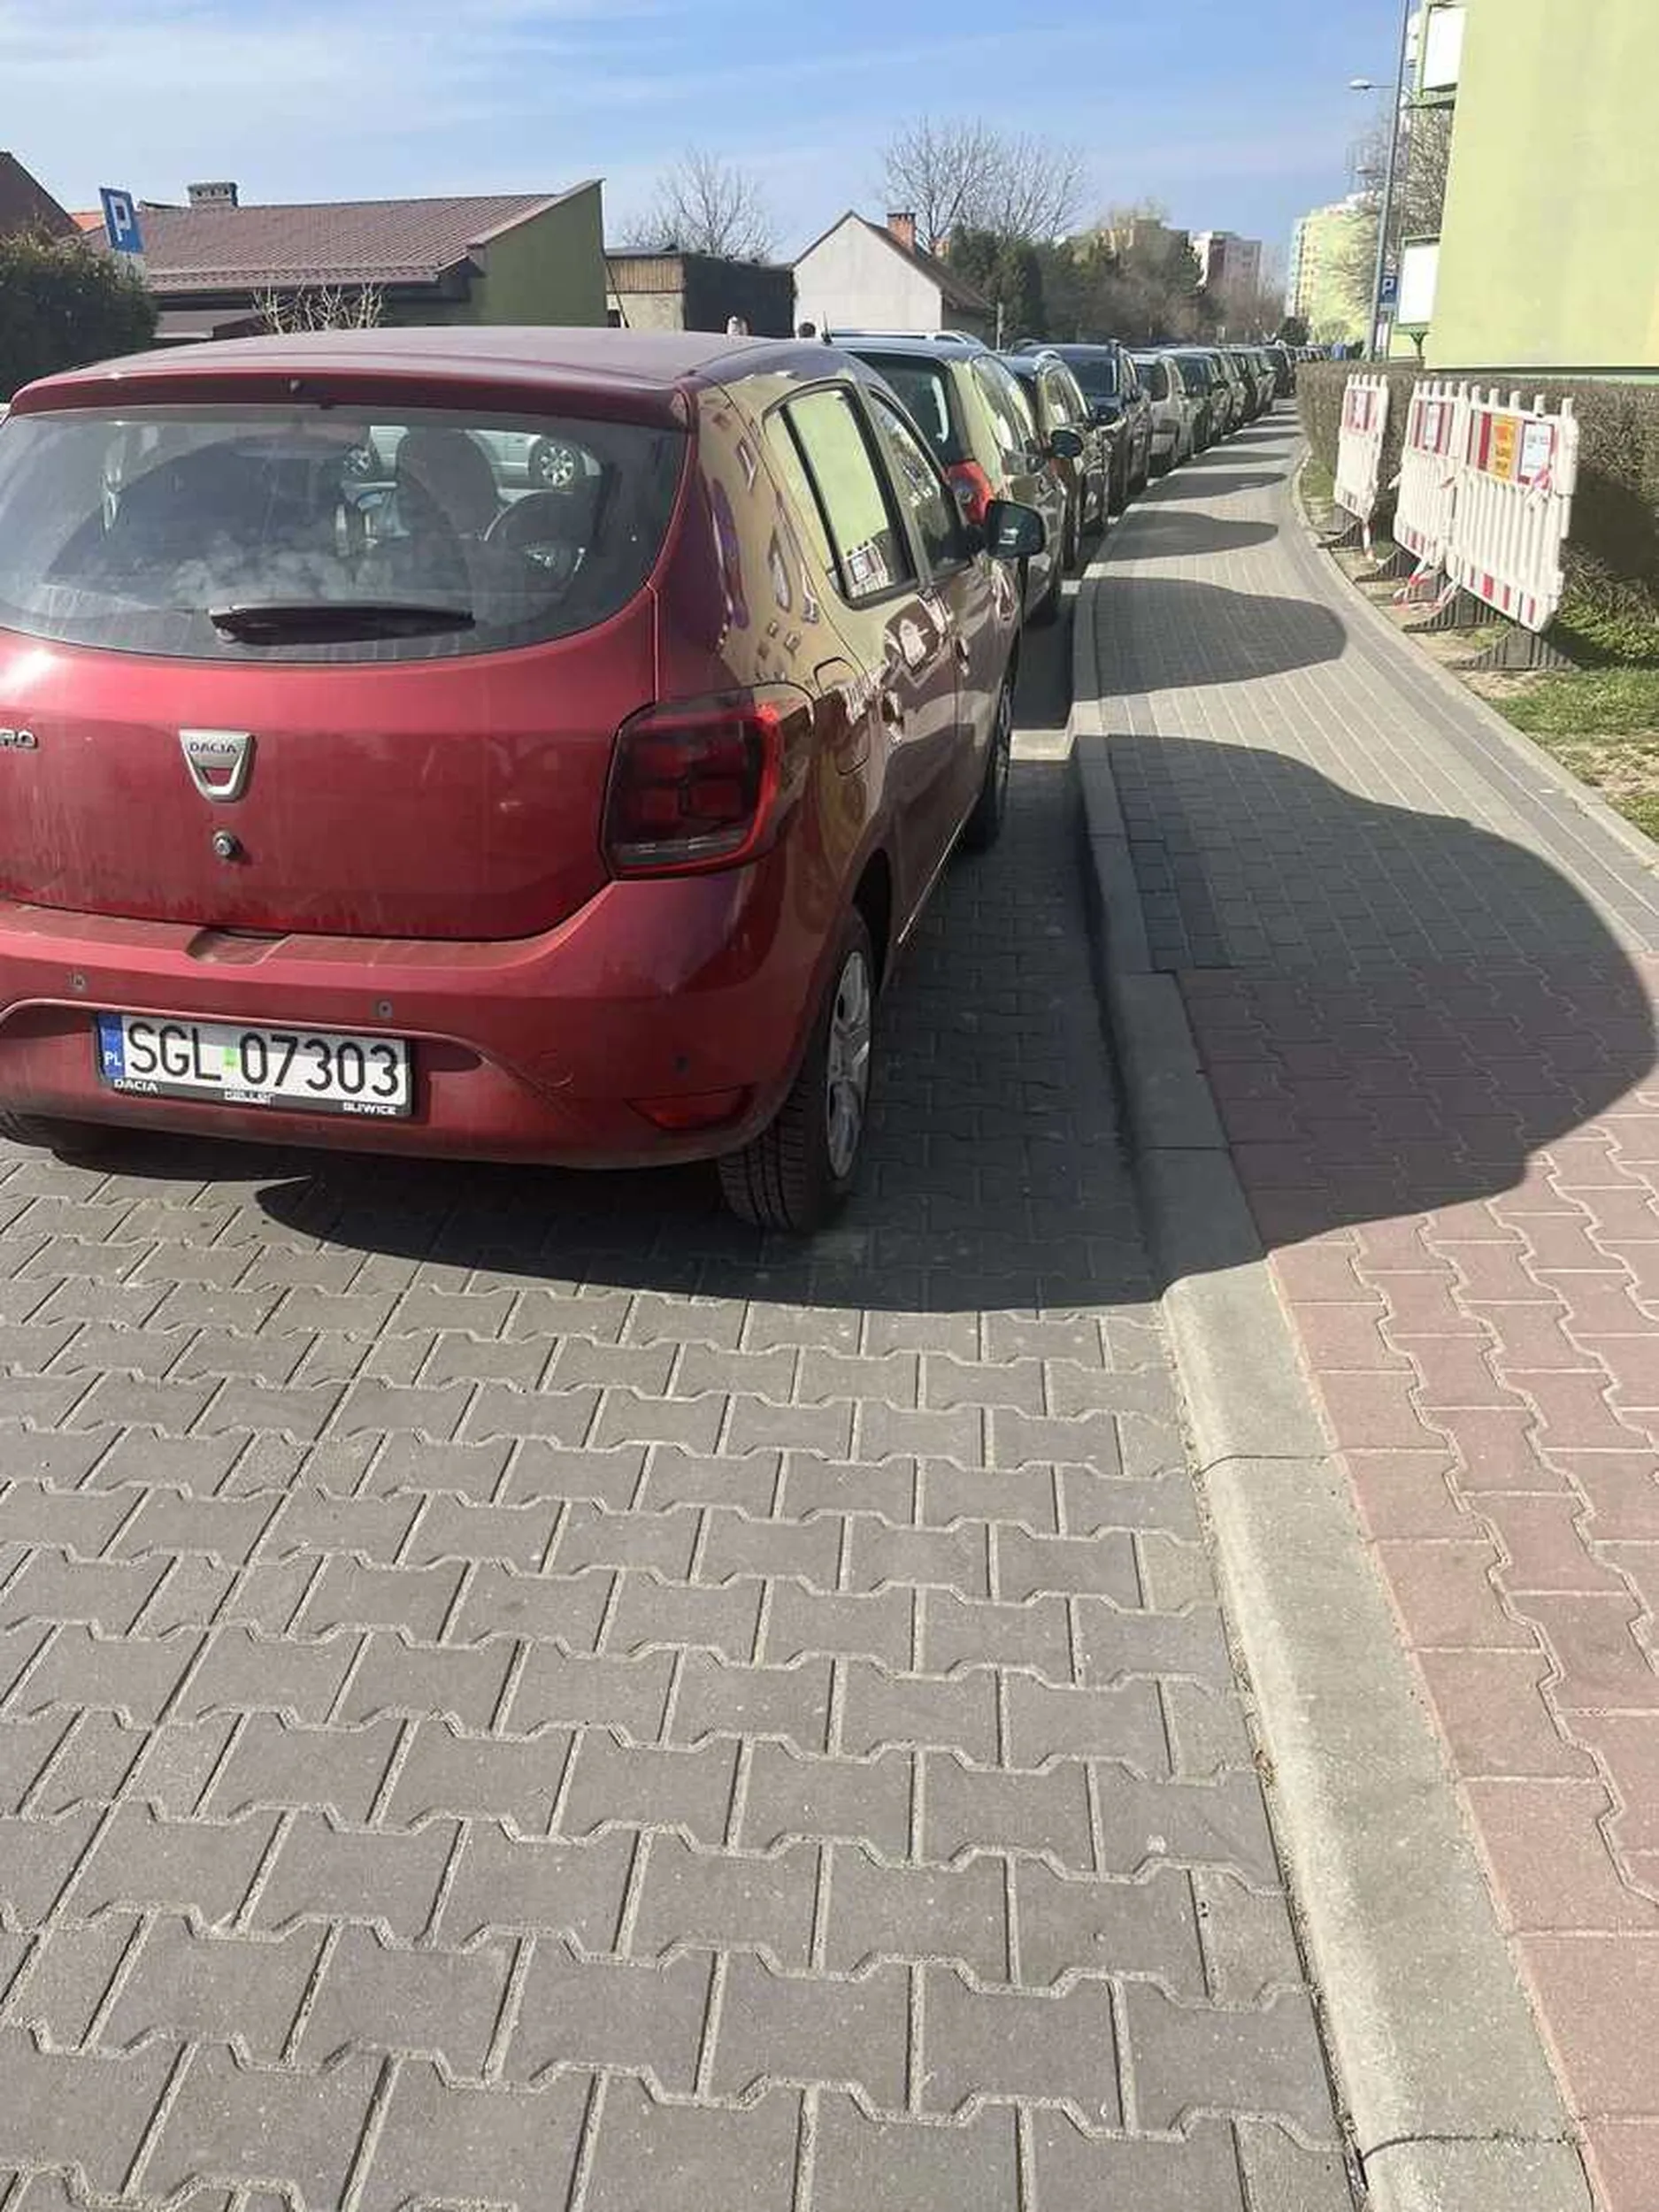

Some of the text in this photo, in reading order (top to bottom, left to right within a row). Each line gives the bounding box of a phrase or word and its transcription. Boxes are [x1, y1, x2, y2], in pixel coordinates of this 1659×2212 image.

[108, 195, 132, 242] P
[1382, 277, 1394, 295] P
[189, 741, 237, 754] DACIA
[104, 1050, 122, 1065] PL
[127, 1021, 400, 1098] SGL 07303
[113, 1079, 158, 1094] DACIA
